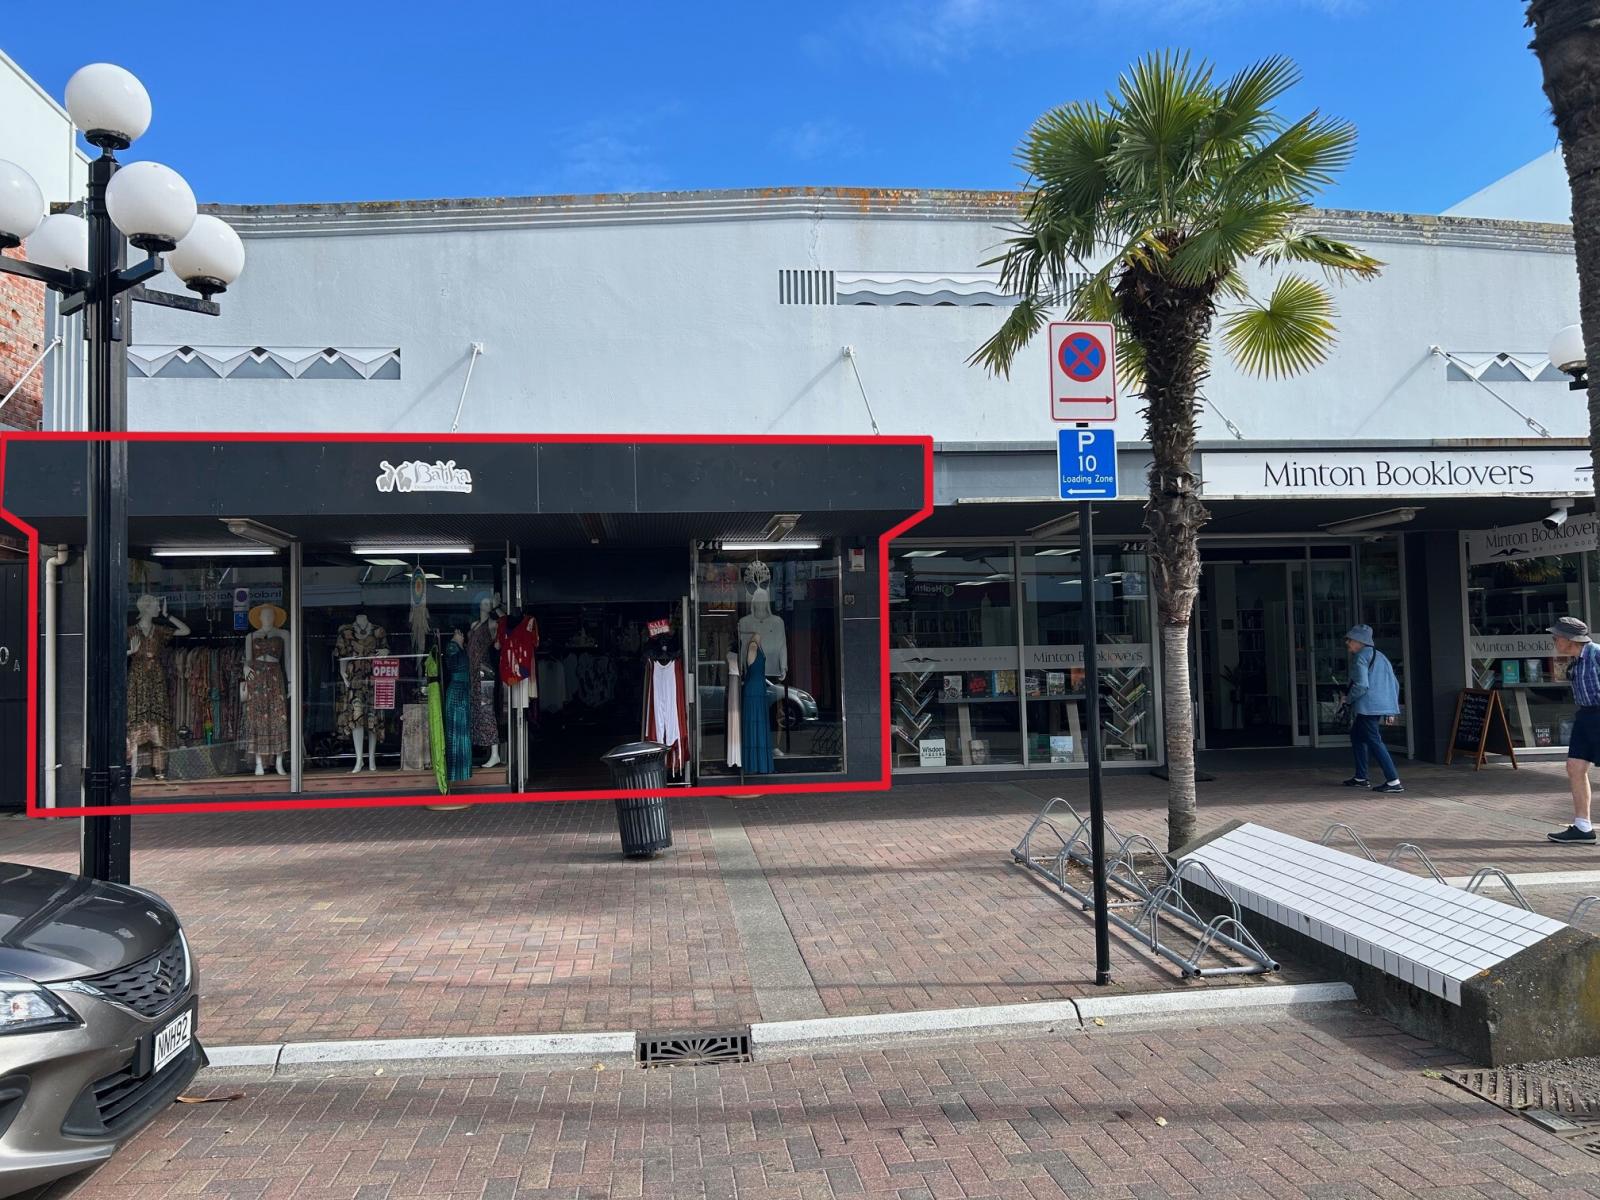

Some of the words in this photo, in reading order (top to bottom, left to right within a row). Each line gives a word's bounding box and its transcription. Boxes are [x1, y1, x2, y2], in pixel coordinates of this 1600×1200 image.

[1078, 431, 1095, 453] P
[414, 460, 471, 485] Batika
[1078, 455, 1097, 472] 10
[1062, 474, 1092, 485] Loading
[1095, 474, 1114, 483] Zone
[1264, 461, 1366, 487] Minton
[1376, 460, 1534, 486] Booklovers
[1485, 532, 1528, 549] Minton
[1531, 520, 1597, 543] Booklover
[1475, 641, 1514, 653] Minton
[1517, 640, 1554, 652] Booklo
[1033, 651, 1075, 664] Minton
[1079, 649, 1143, 662] Bklovers
[373, 666, 398, 677] OPEN
[157, 1016, 188, 1061] NNH92
